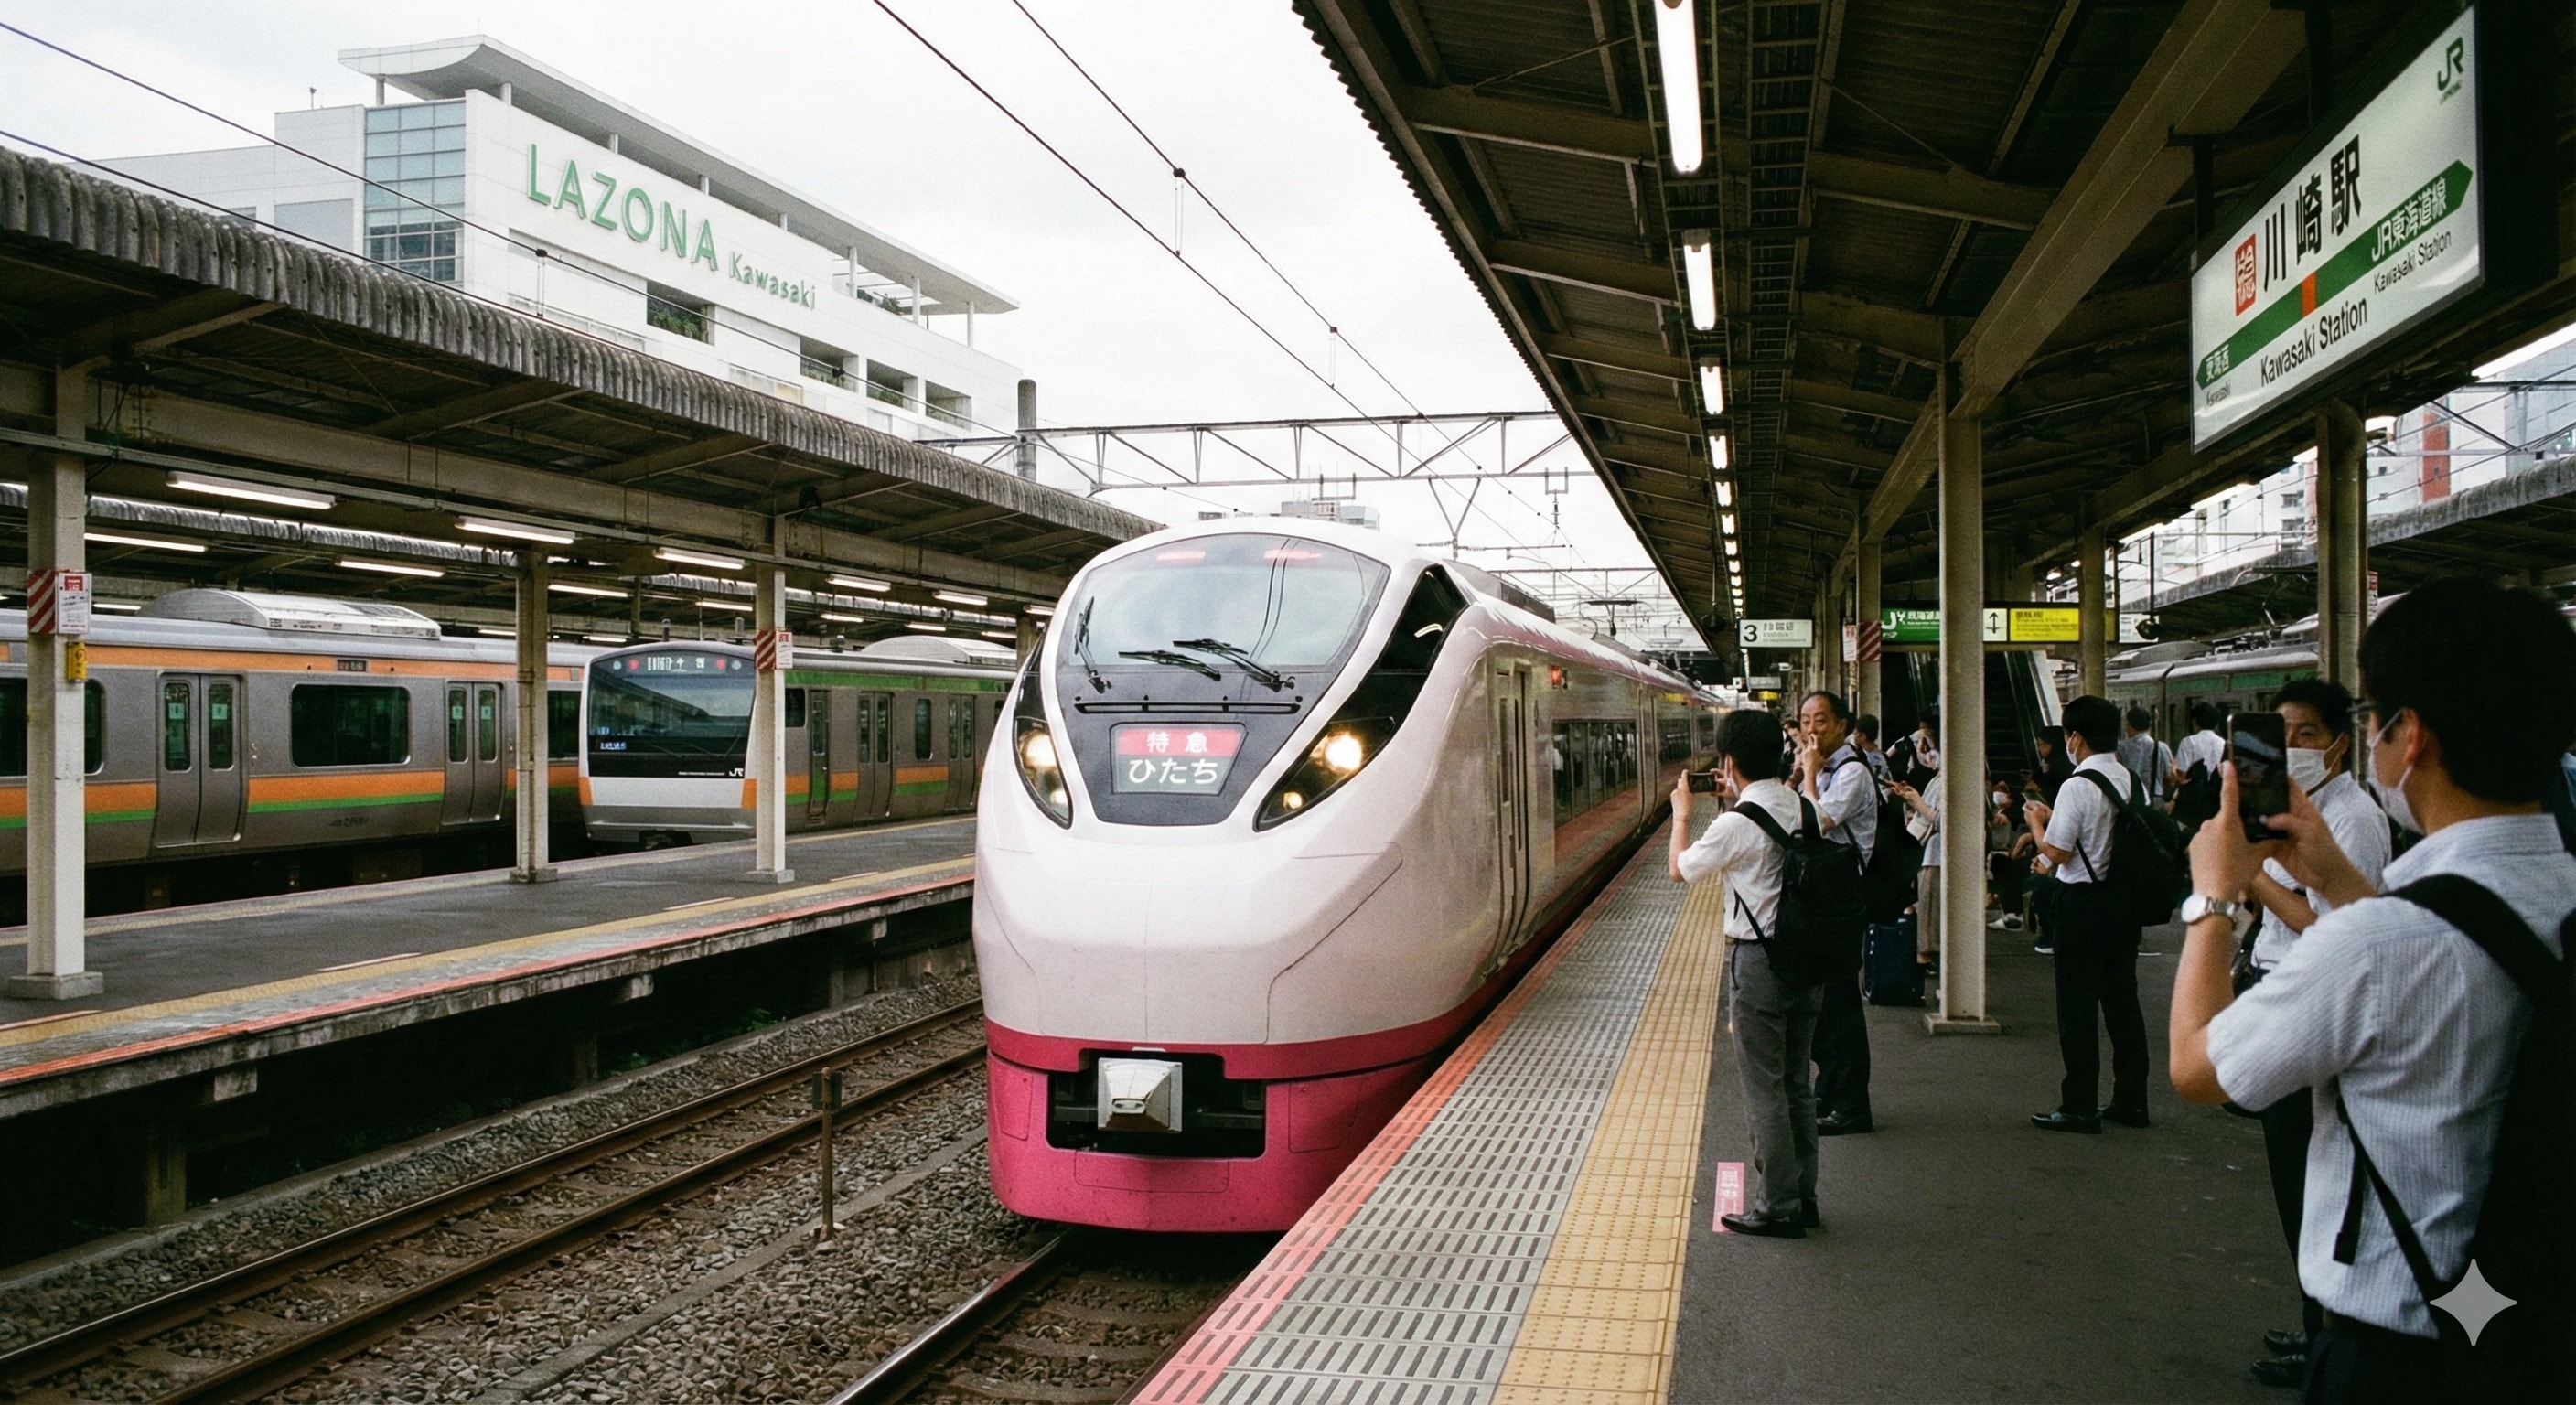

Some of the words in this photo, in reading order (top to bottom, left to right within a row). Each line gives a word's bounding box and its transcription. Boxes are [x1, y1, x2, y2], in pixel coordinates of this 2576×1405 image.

[2438, 37, 2463, 91] JR
[527, 143, 719, 271] LAZONA
[729, 251, 816, 310] Kawasaki
[2264, 134, 2361, 293] 川崎駅
[2418, 231, 2452, 266] Station
[2261, 323, 2315, 387] Kawasaki
[2319, 298, 2367, 349] Station
[1744, 624, 1757, 642] 3
[1146, 731, 1208, 753] 特急
[728, 767, 744, 777] JR
[1128, 757, 1218, 785] ひたち
